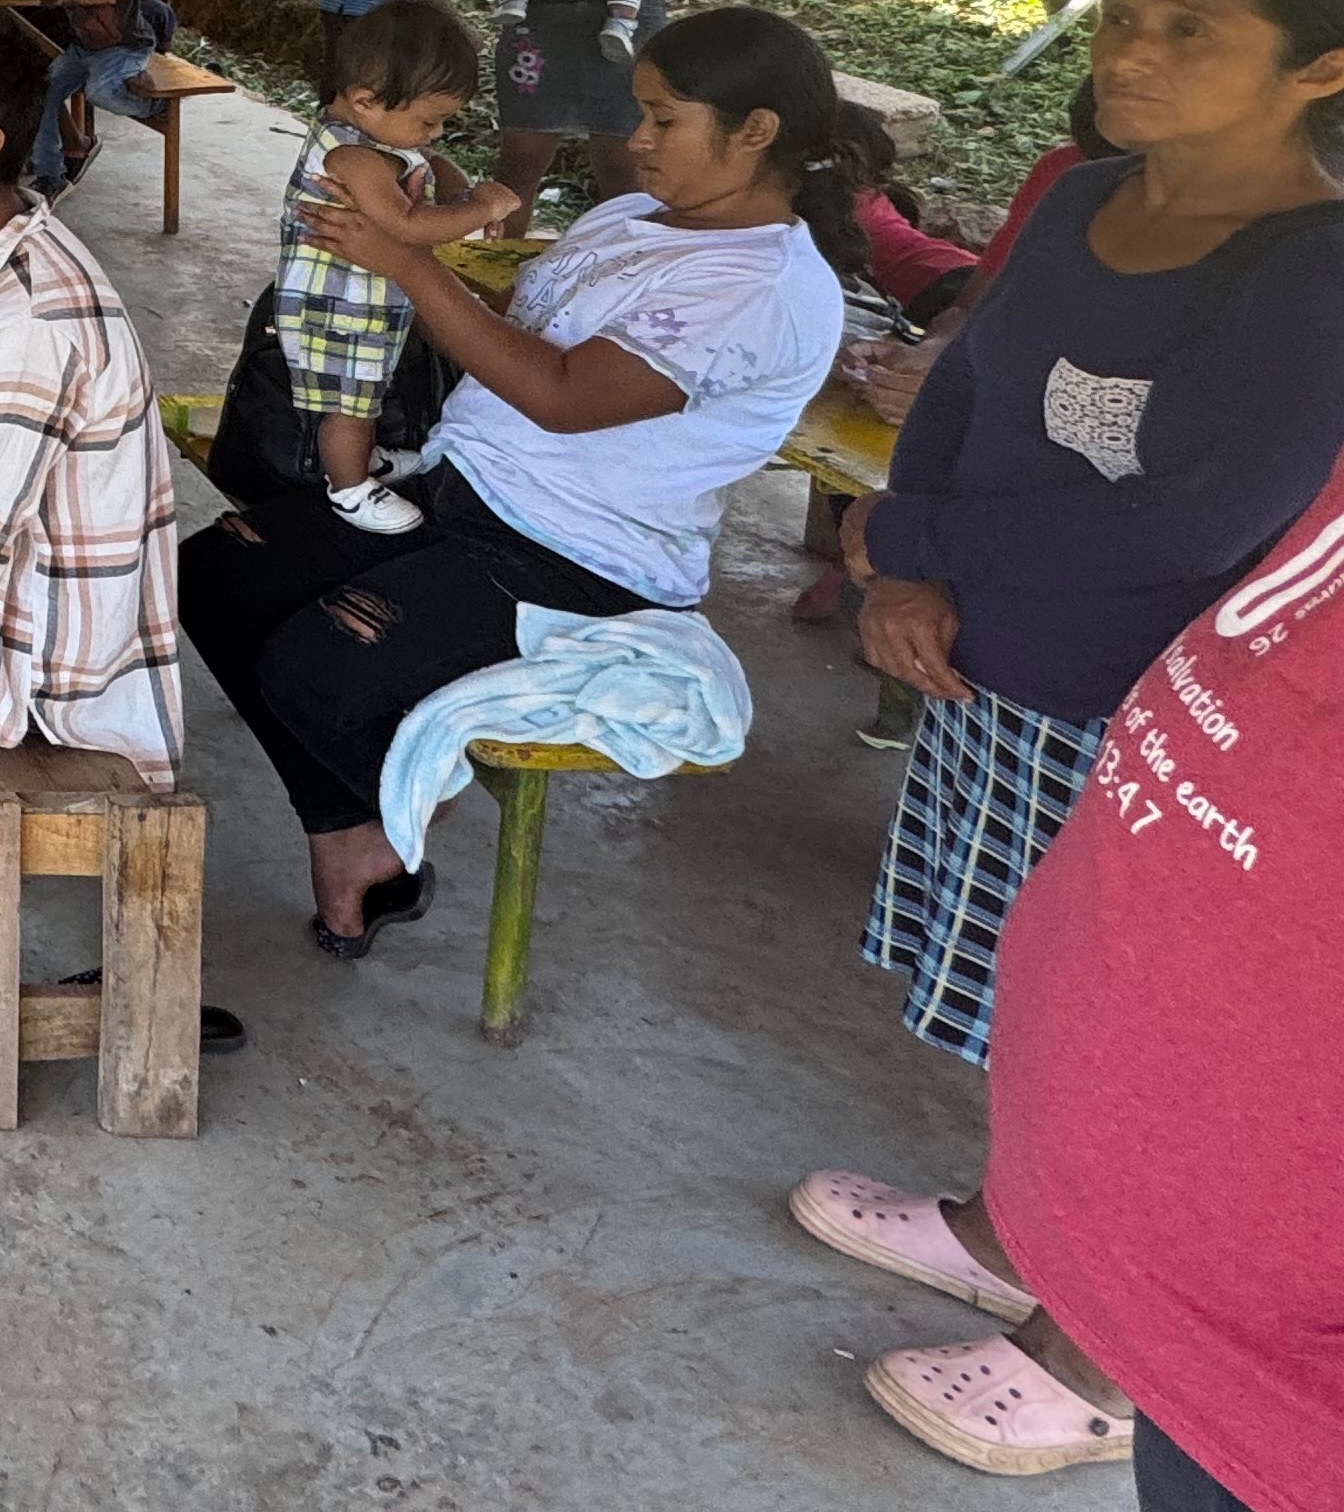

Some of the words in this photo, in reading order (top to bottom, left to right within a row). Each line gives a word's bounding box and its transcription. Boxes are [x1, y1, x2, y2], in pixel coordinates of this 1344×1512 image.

[1248, 622, 1289, 657] 26
[1125, 706, 1154, 735] of
[1140, 728, 1176, 783] the
[1176, 780, 1258, 872] earth
